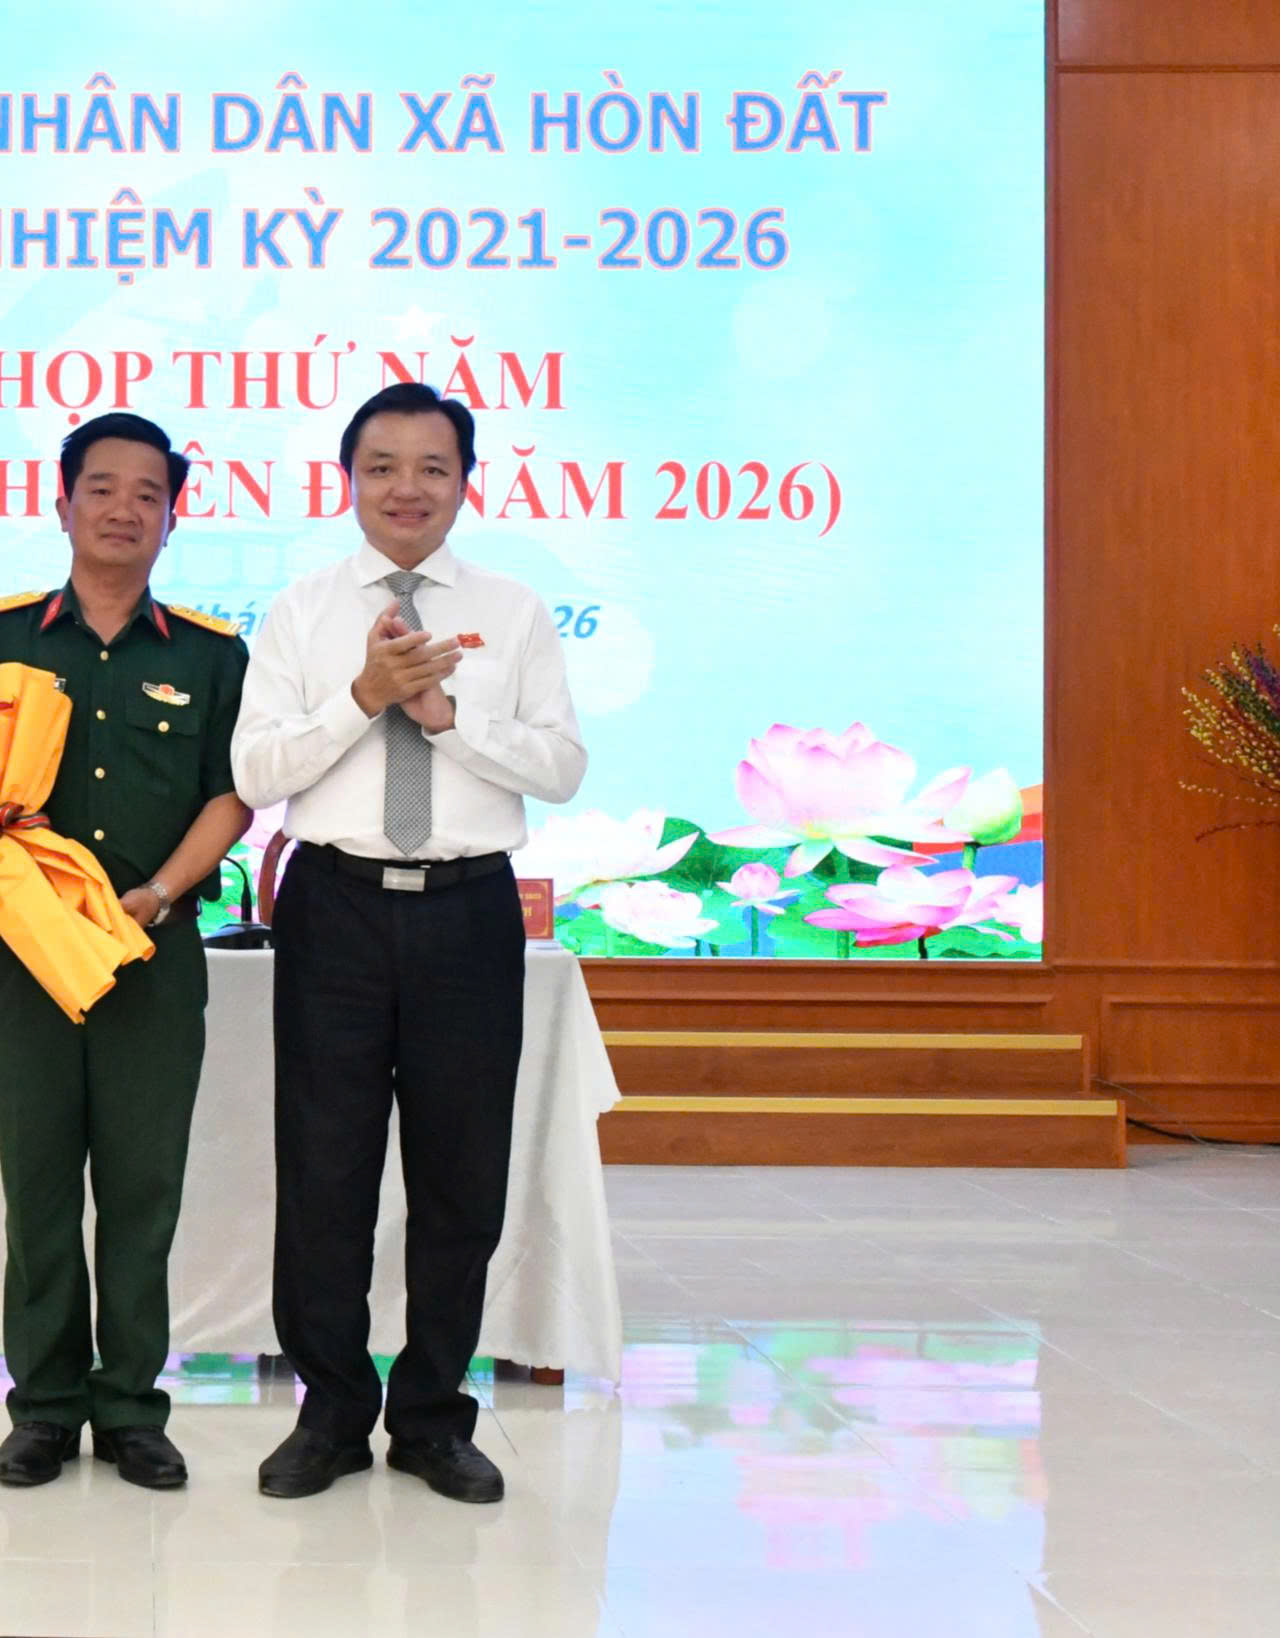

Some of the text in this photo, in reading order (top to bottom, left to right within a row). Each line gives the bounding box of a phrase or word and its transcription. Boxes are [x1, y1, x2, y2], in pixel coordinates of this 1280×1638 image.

[211, 71, 374, 155] DÂN
[399, 73, 506, 154] XÃ
[530, 70, 702, 155] HÒN
[726, 70, 890, 154] ĐẤT
[241, 187, 345, 270] KỲ
[369, 207, 792, 272] 2021-2026
[173, 333, 358, 412] THỨ
[654, 460, 843, 538] 2026)
